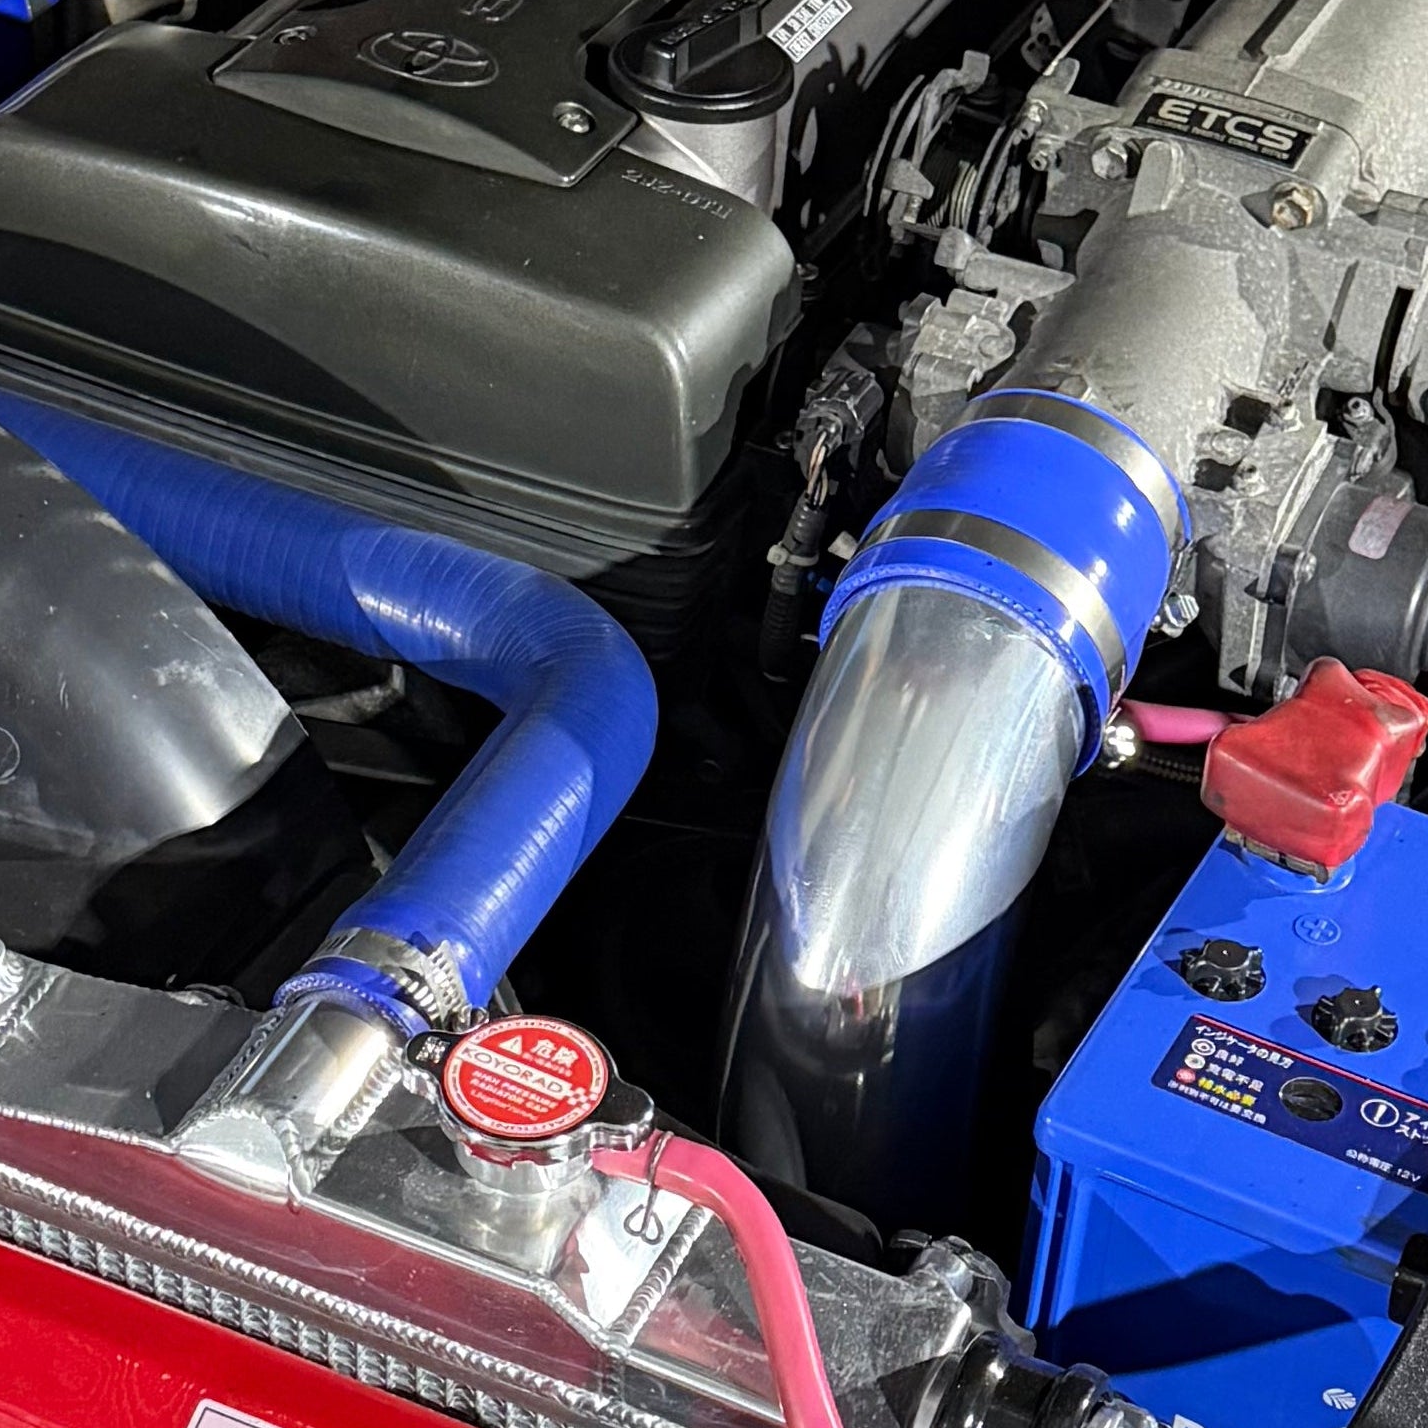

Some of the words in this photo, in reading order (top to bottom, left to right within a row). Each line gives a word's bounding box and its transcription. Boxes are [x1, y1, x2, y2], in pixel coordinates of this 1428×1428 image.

[1157, 97, 1299, 153] ETCS
[531, 1038, 579, 1068] 危険
[1194, 1024, 1295, 1070] インジケータの見方
[460, 1046, 564, 1095] KOYORAD
[1396, 1167, 1422, 1183] 12V
